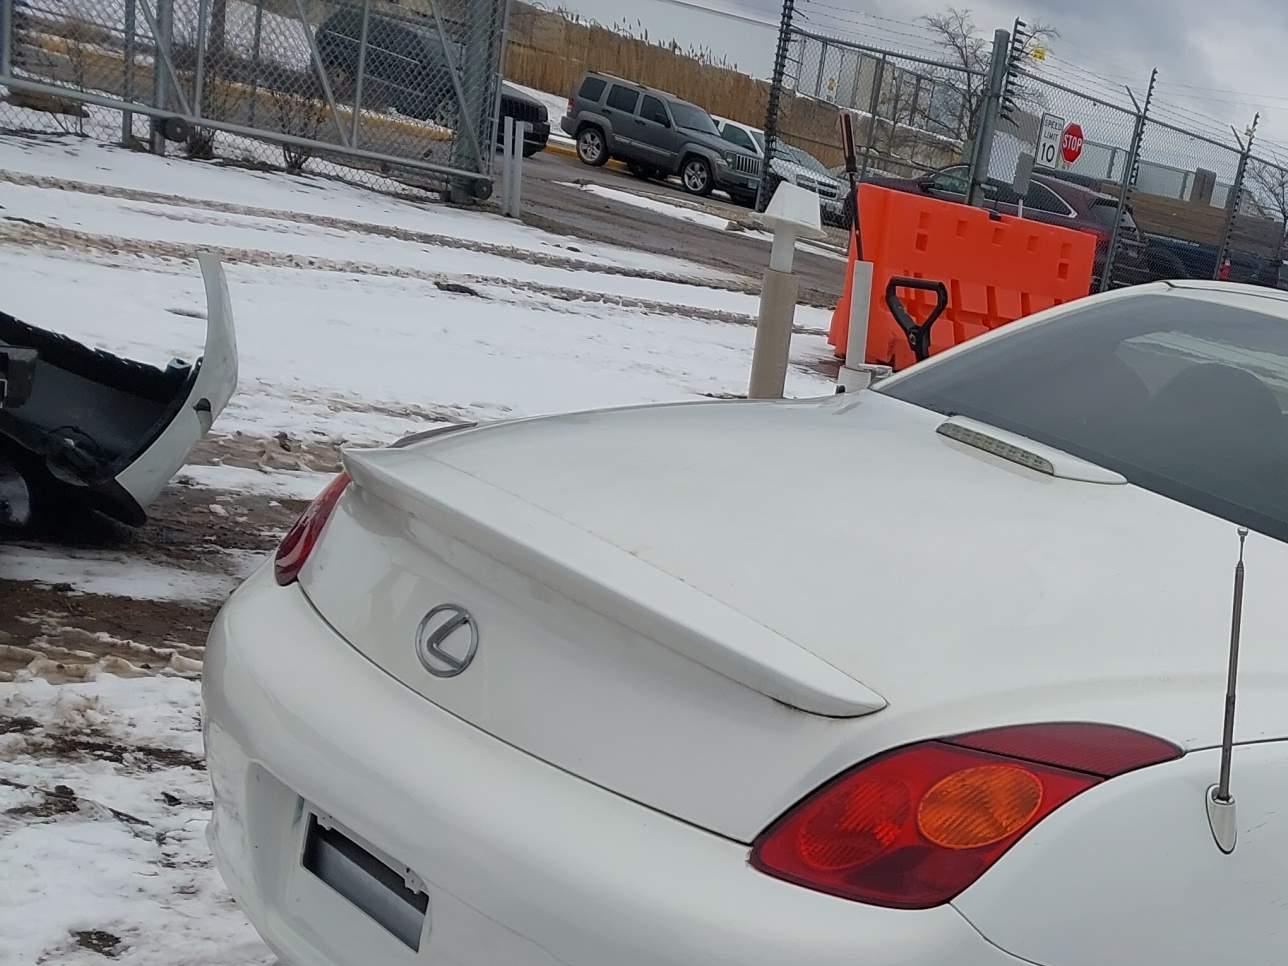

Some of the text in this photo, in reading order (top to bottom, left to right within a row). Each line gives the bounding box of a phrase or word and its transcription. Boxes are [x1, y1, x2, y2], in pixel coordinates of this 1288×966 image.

[1044, 119, 1063, 131] SPEED
[1043, 131, 1059, 142] LIMIT
[1062, 134, 1083, 152] STOP
[1041, 142, 1055, 162] 10
